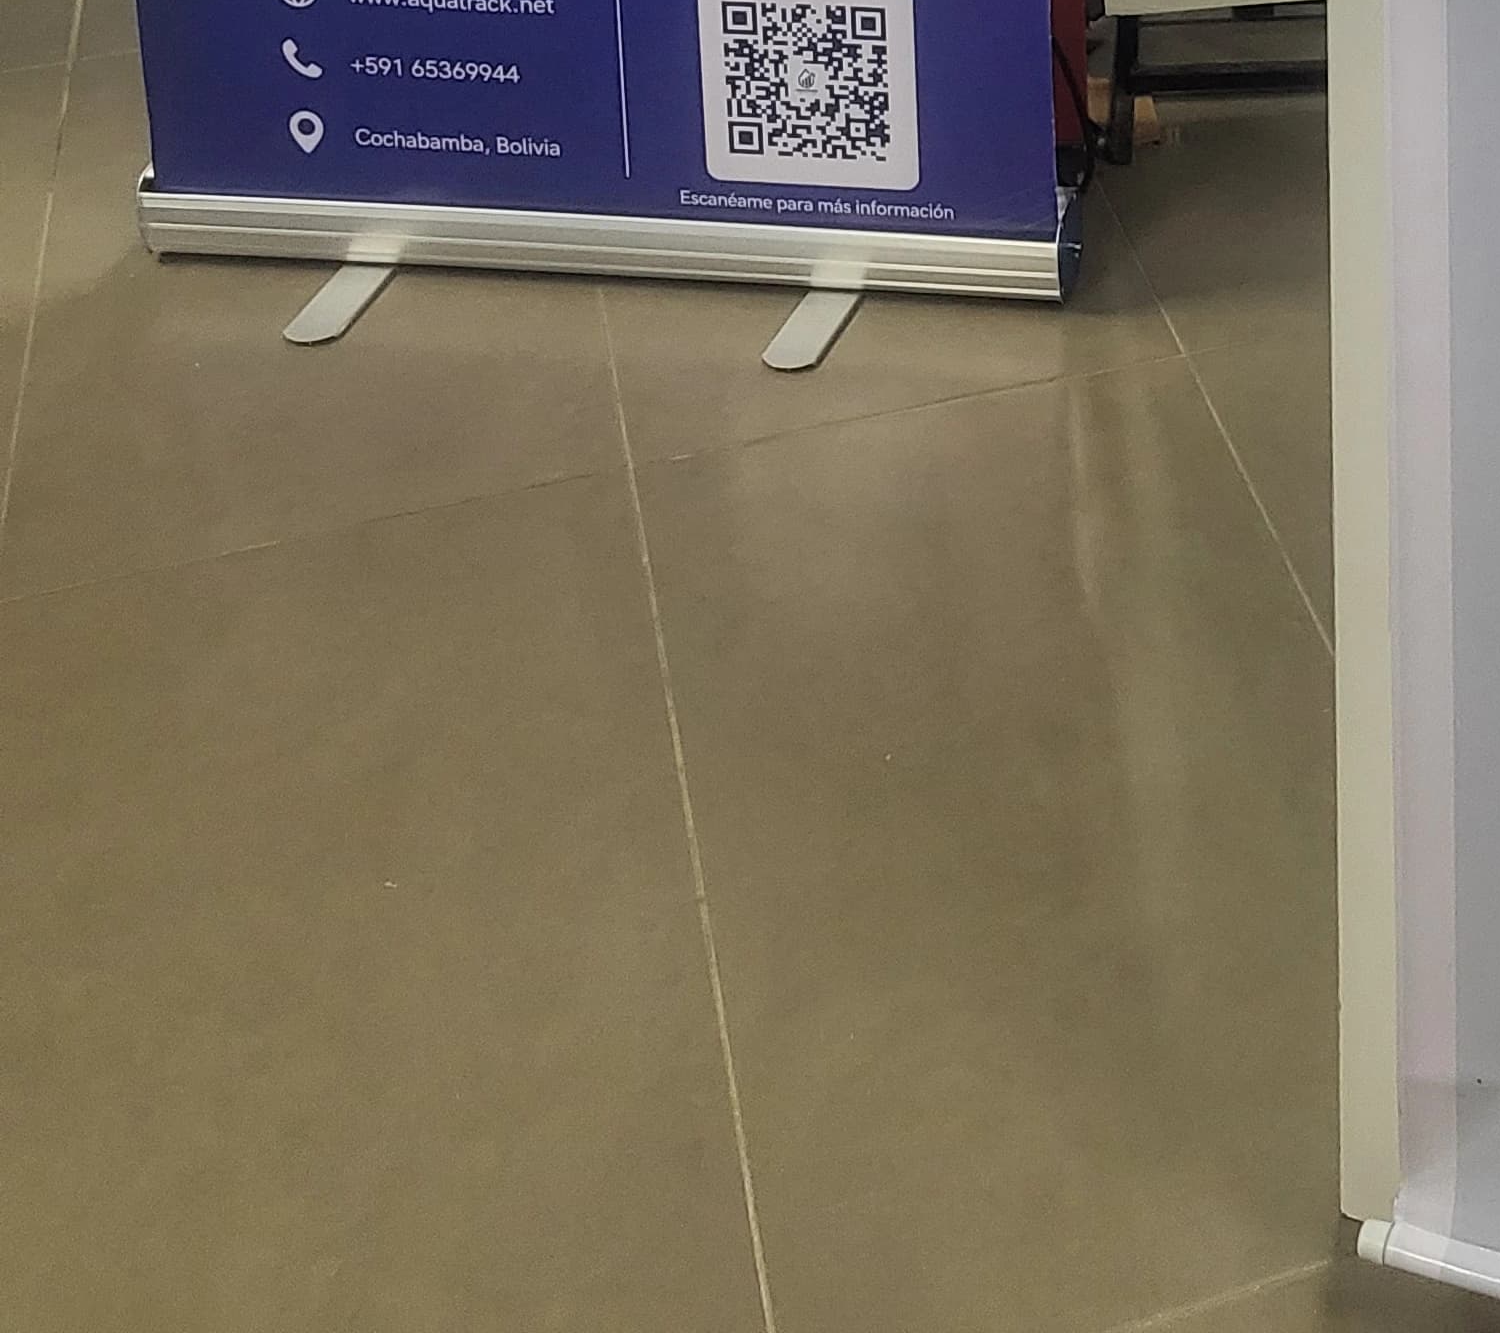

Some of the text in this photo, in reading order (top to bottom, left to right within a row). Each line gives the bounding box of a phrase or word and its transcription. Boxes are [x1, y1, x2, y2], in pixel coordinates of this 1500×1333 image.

[350, 55, 520, 85] +591 65369944
[355, 128, 561, 159] Cochabamba, Bolivia
[680, 189, 955, 221] Escanéame para más información
